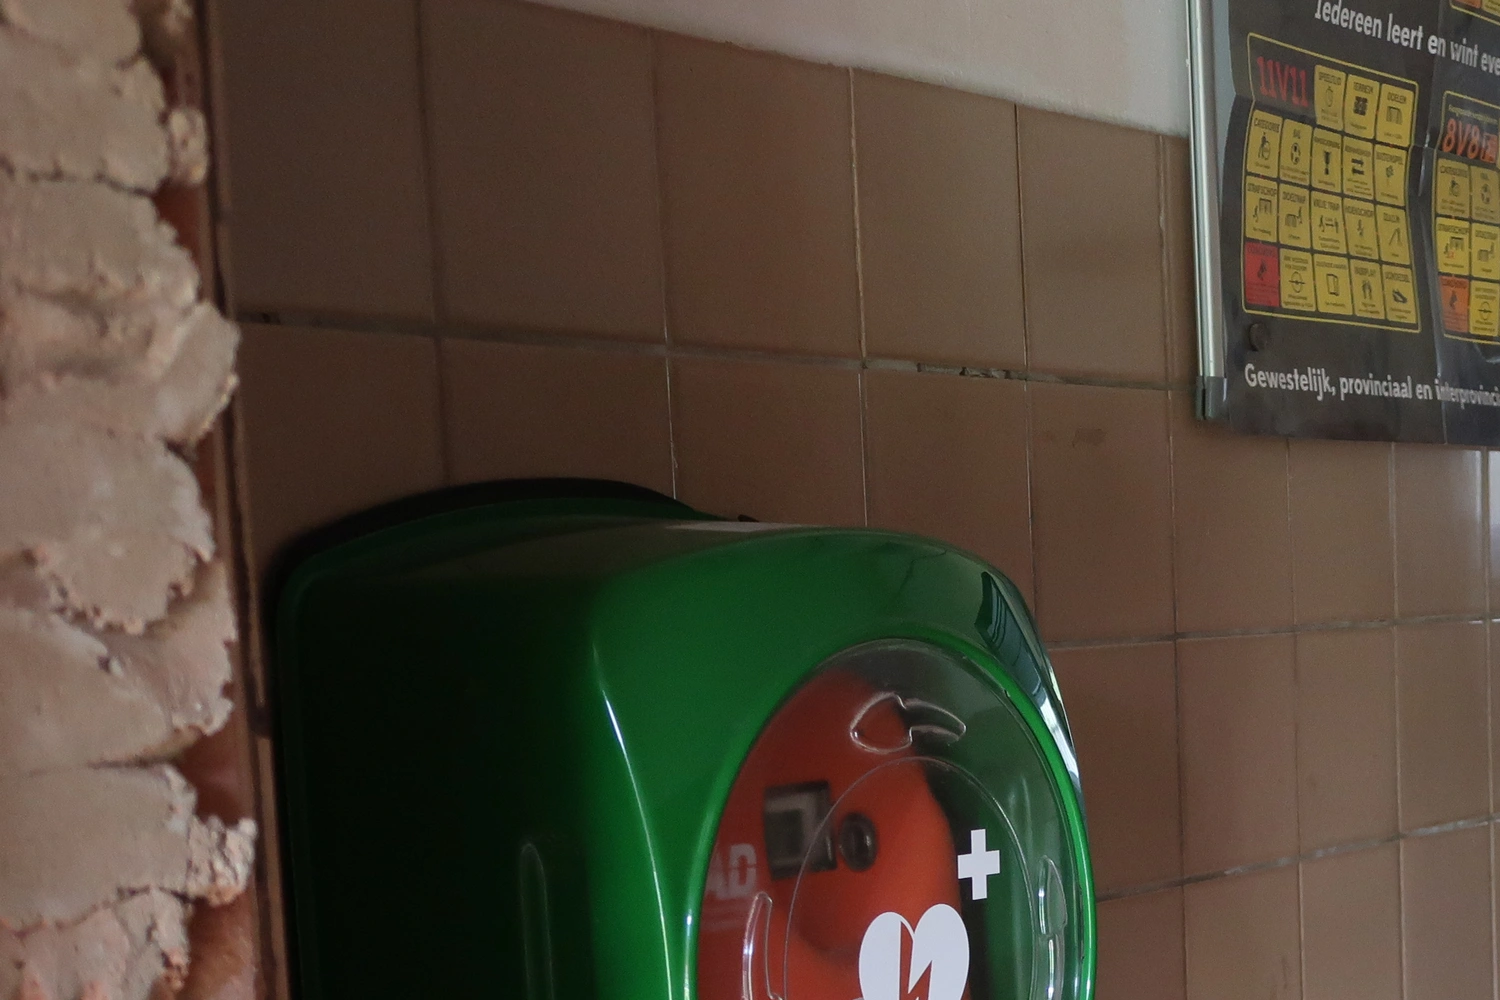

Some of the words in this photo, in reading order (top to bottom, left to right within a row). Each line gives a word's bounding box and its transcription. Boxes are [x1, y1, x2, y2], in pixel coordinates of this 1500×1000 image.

[1314, 0, 1382, 39] Iedereen
[1387, 13, 1423, 50] leert
[1427, 34, 1446, 58] en
[1450, 37, 1478, 68] wint
[1256, 56, 1309, 107] 11V11
[1244, 363, 1336, 401] Gewestelijk,
[1339, 373, 1413, 401] provinciaal
[1415, 382, 1433, 400] en
